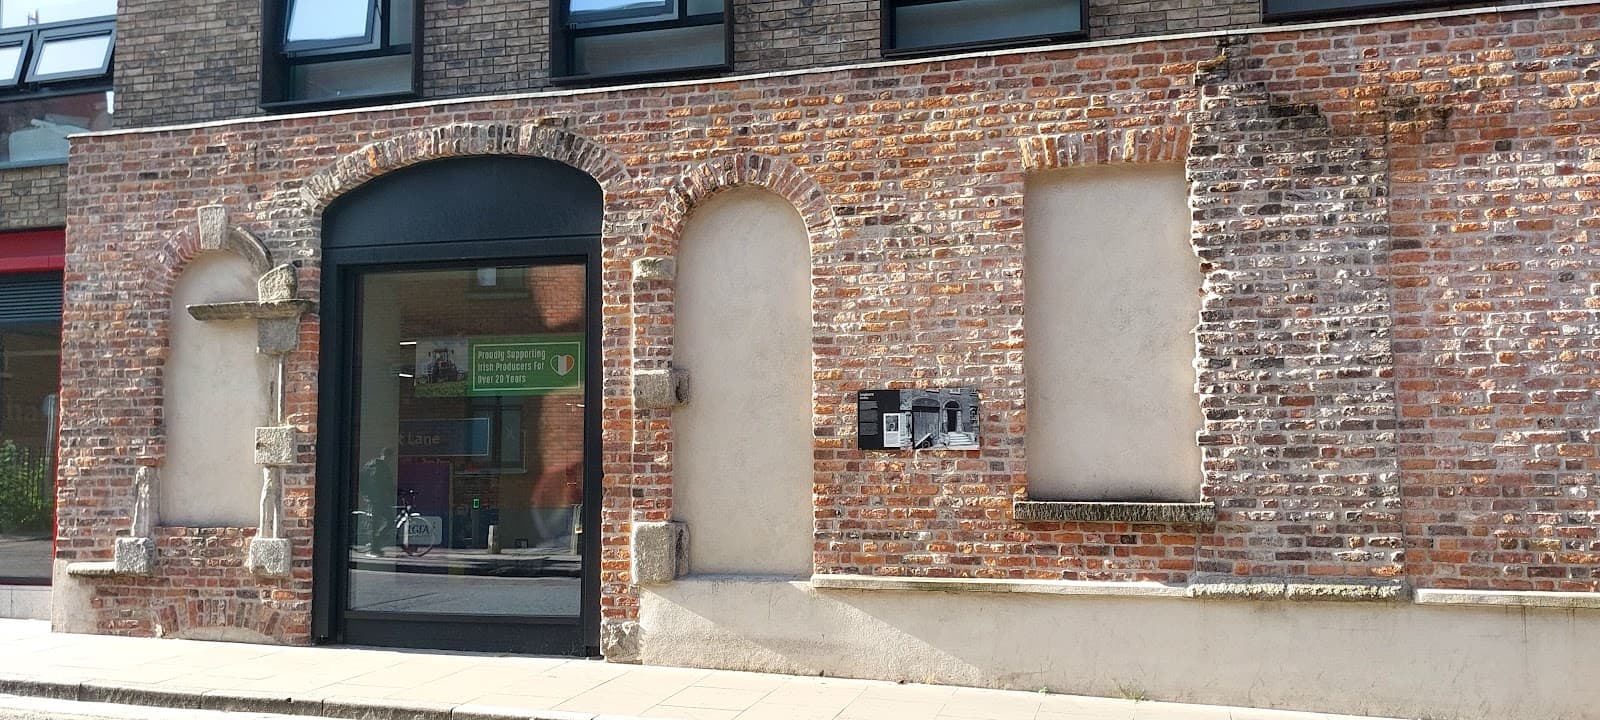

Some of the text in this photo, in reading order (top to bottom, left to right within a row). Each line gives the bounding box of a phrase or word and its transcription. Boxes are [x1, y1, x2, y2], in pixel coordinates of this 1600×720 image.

[478, 349, 545, 361] Proudly Supporting
[477, 361, 545, 373] Irish Producers For
[477, 374, 526, 384] Over 20 Years
[408, 431, 441, 445] Lane
